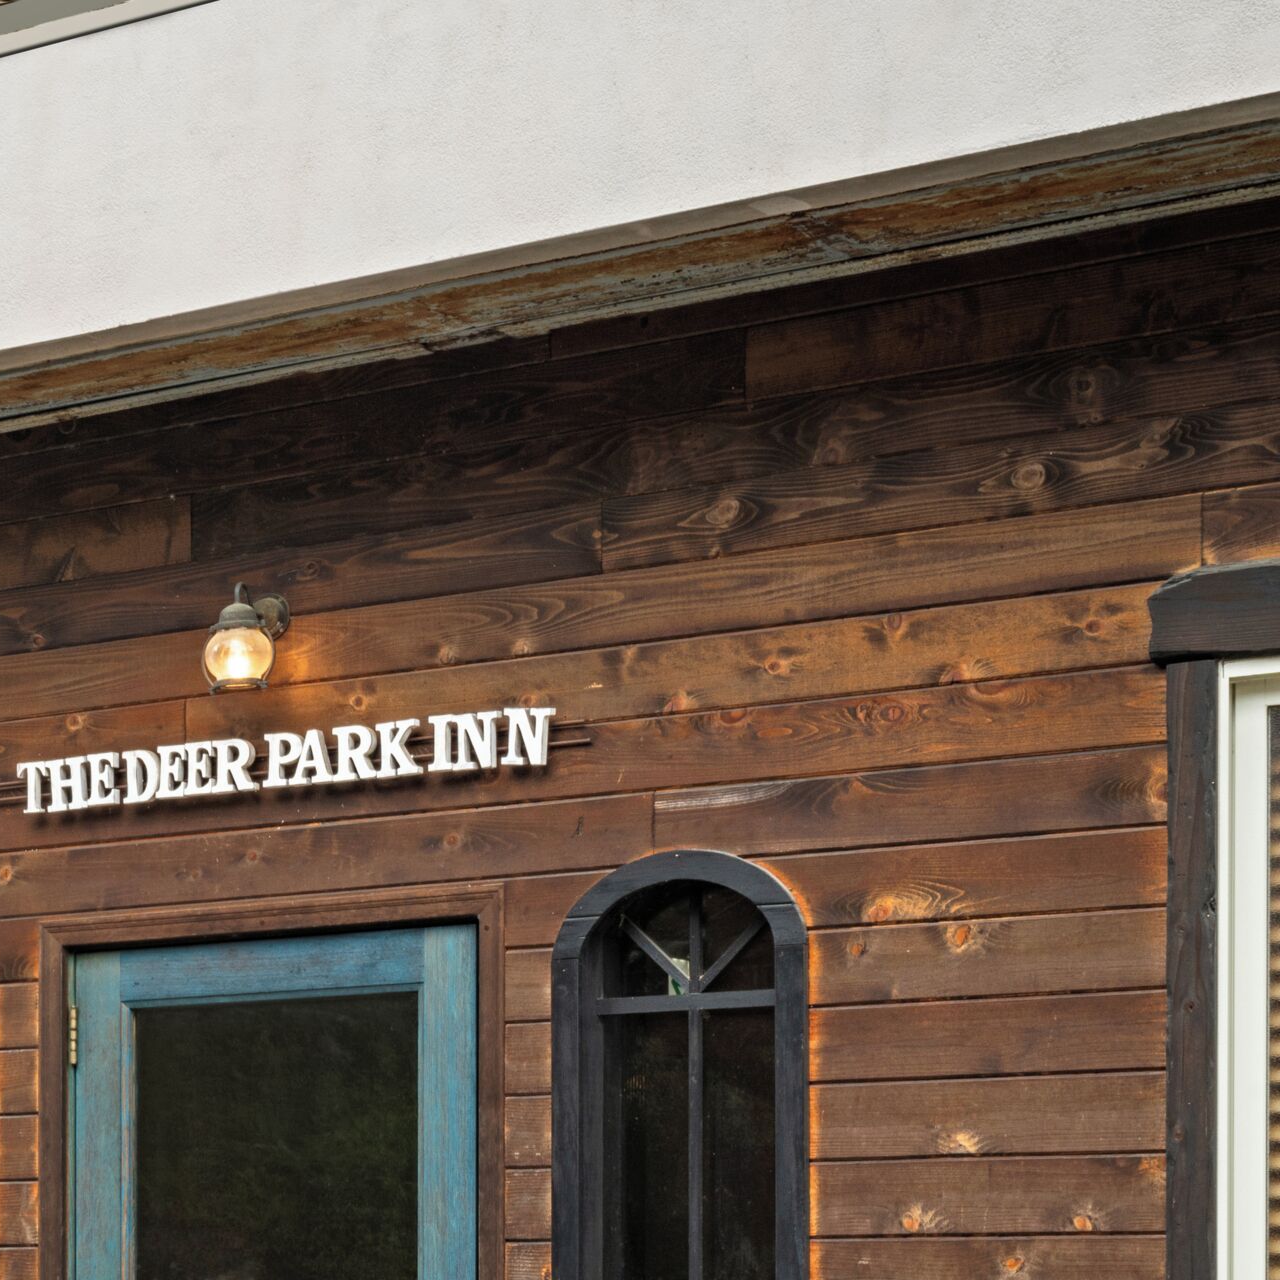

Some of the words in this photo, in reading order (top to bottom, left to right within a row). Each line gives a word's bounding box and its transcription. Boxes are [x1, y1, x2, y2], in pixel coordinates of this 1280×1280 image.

[16, 751, 121, 814] THE
[121, 738, 260, 805] DEER
[262, 718, 424, 788] PARK
[427, 707, 557, 772] INN
